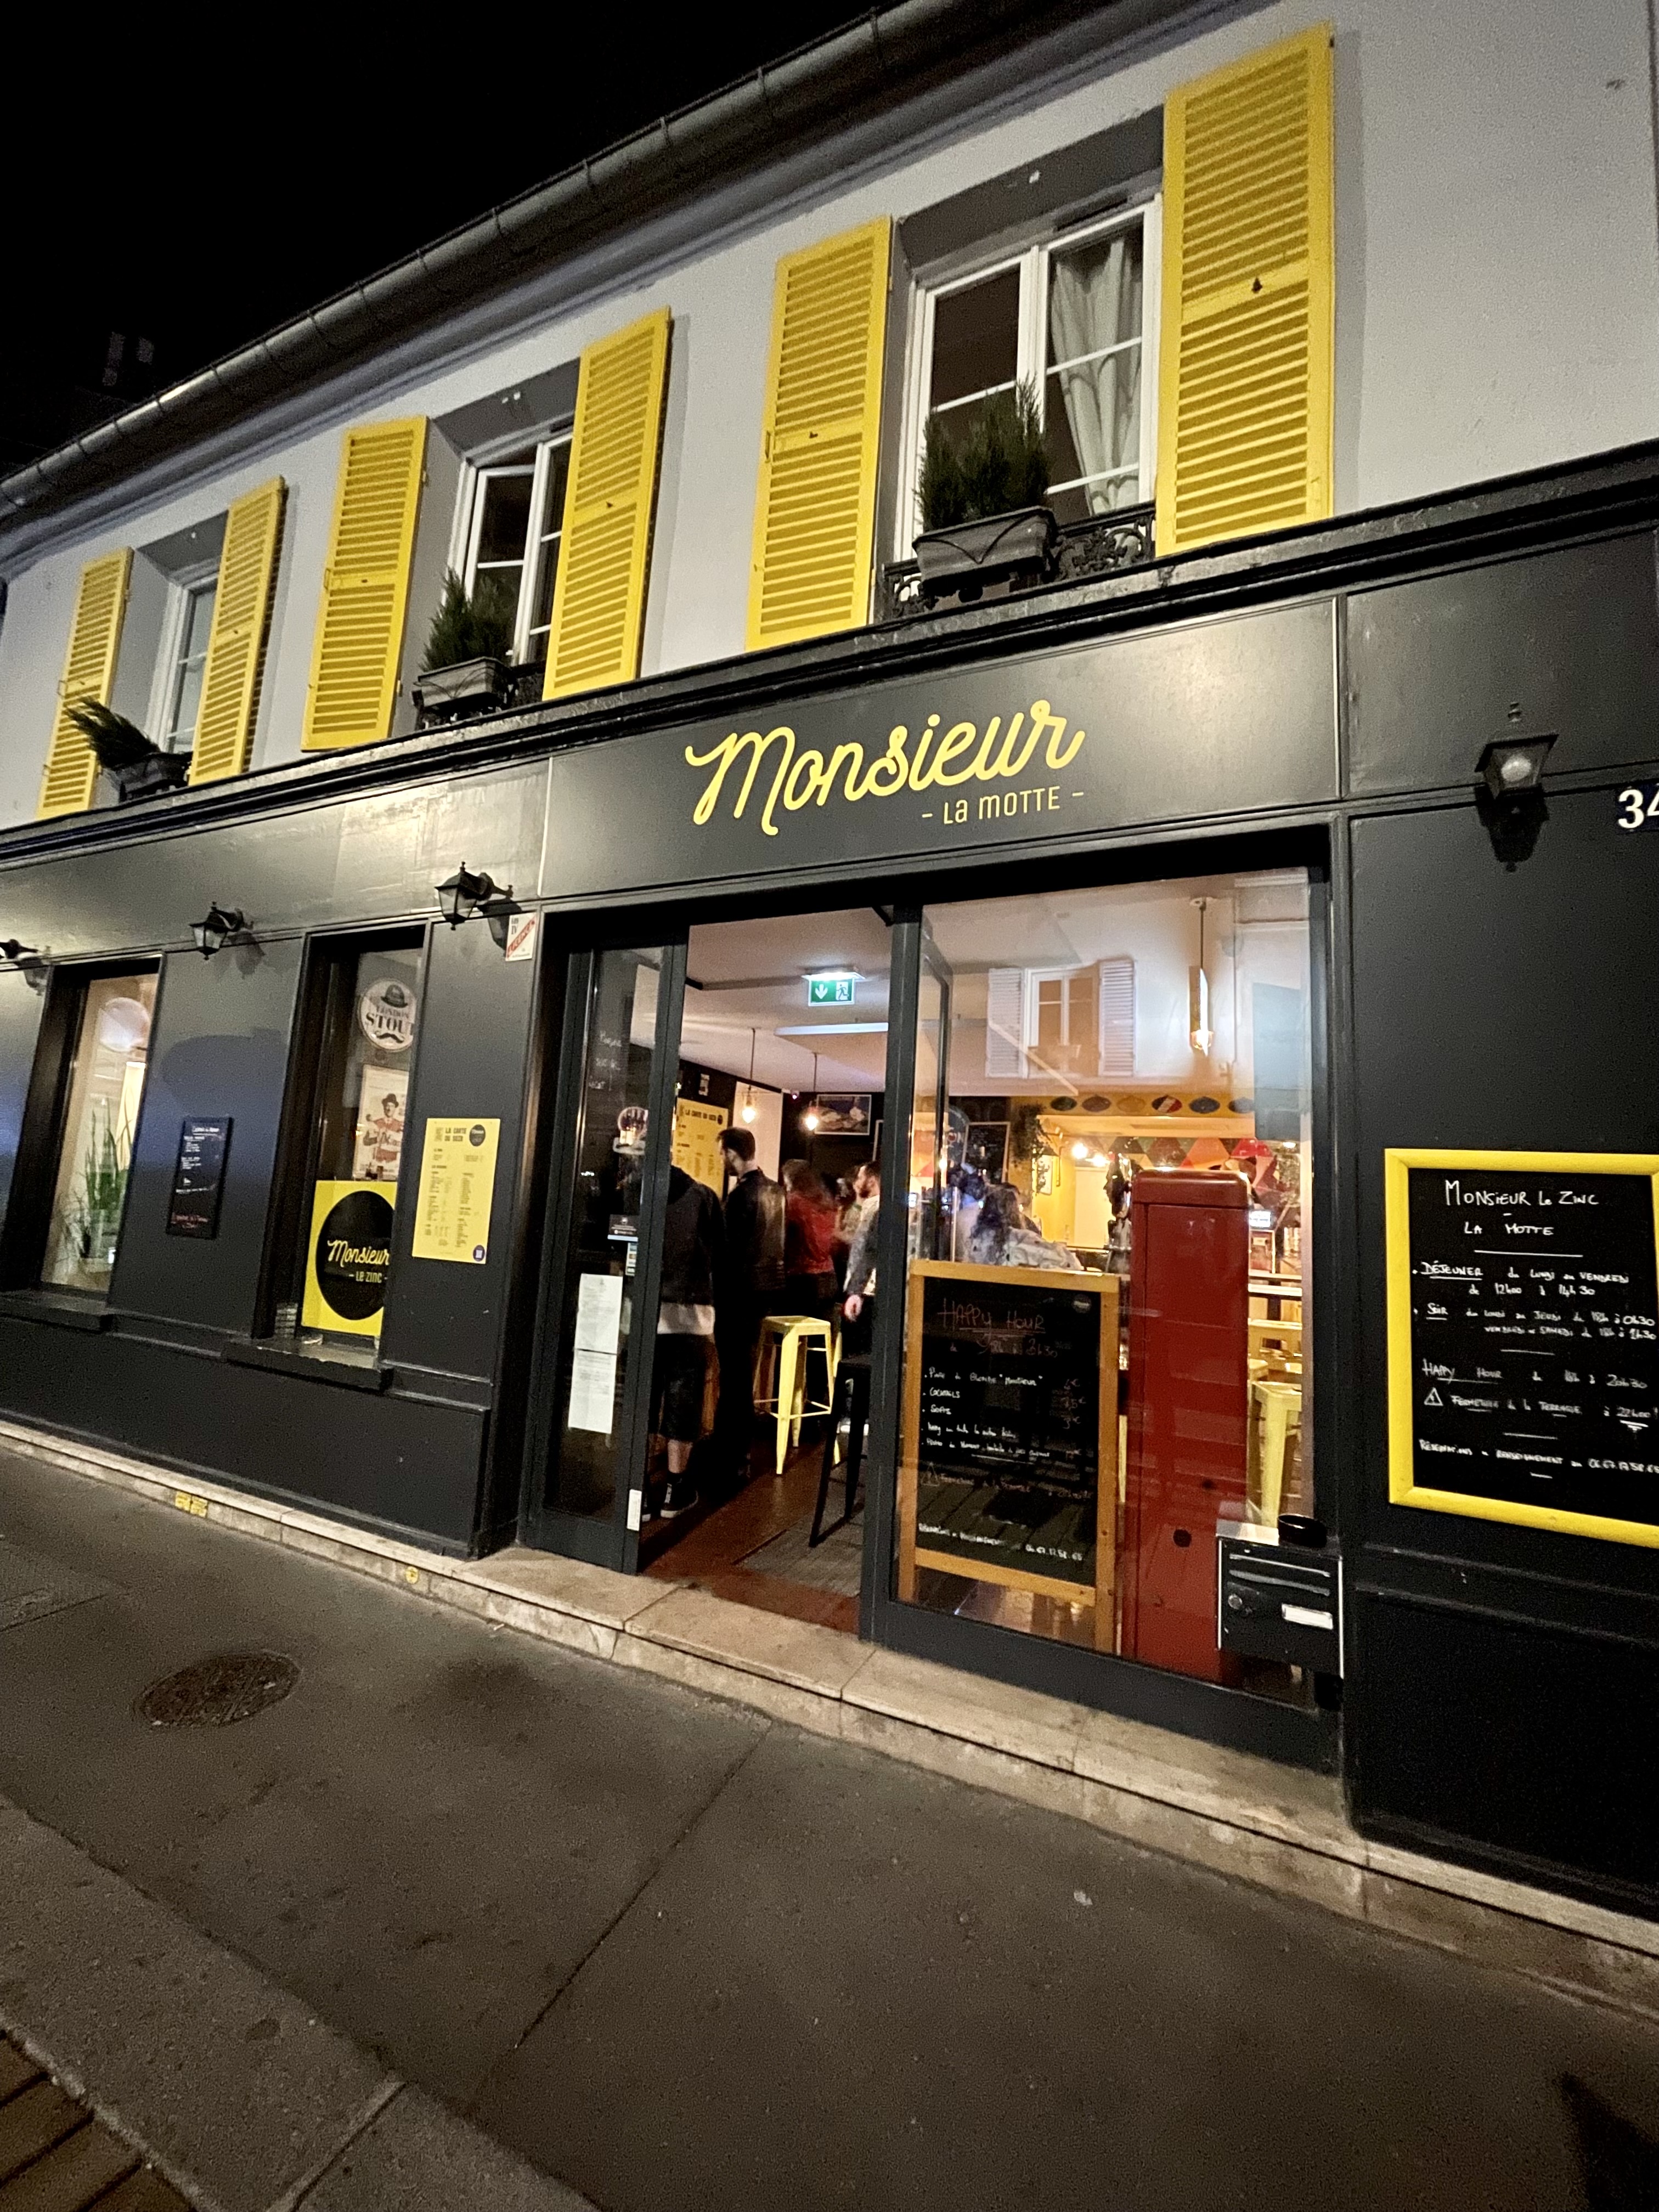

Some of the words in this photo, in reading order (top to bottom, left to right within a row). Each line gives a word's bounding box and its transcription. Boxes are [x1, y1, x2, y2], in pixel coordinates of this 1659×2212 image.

[685, 699, 1085, 836] Monsieur
[1464, 1222, 1482, 1234] LA
[1505, 1223, 1554, 1235] MOTTE
[327, 1239, 390, 1268] Monsieur
[1421, 1260, 1483, 1276] DÉJEUNER
[1468, 1284, 1480, 1295] de
[1495, 1283, 1522, 1295] 12h00
[937, 1297, 992, 1346] HAPPY
[1007, 1310, 1045, 1330] HOUR
[1421, 1358, 1455, 1384] HAPPY
